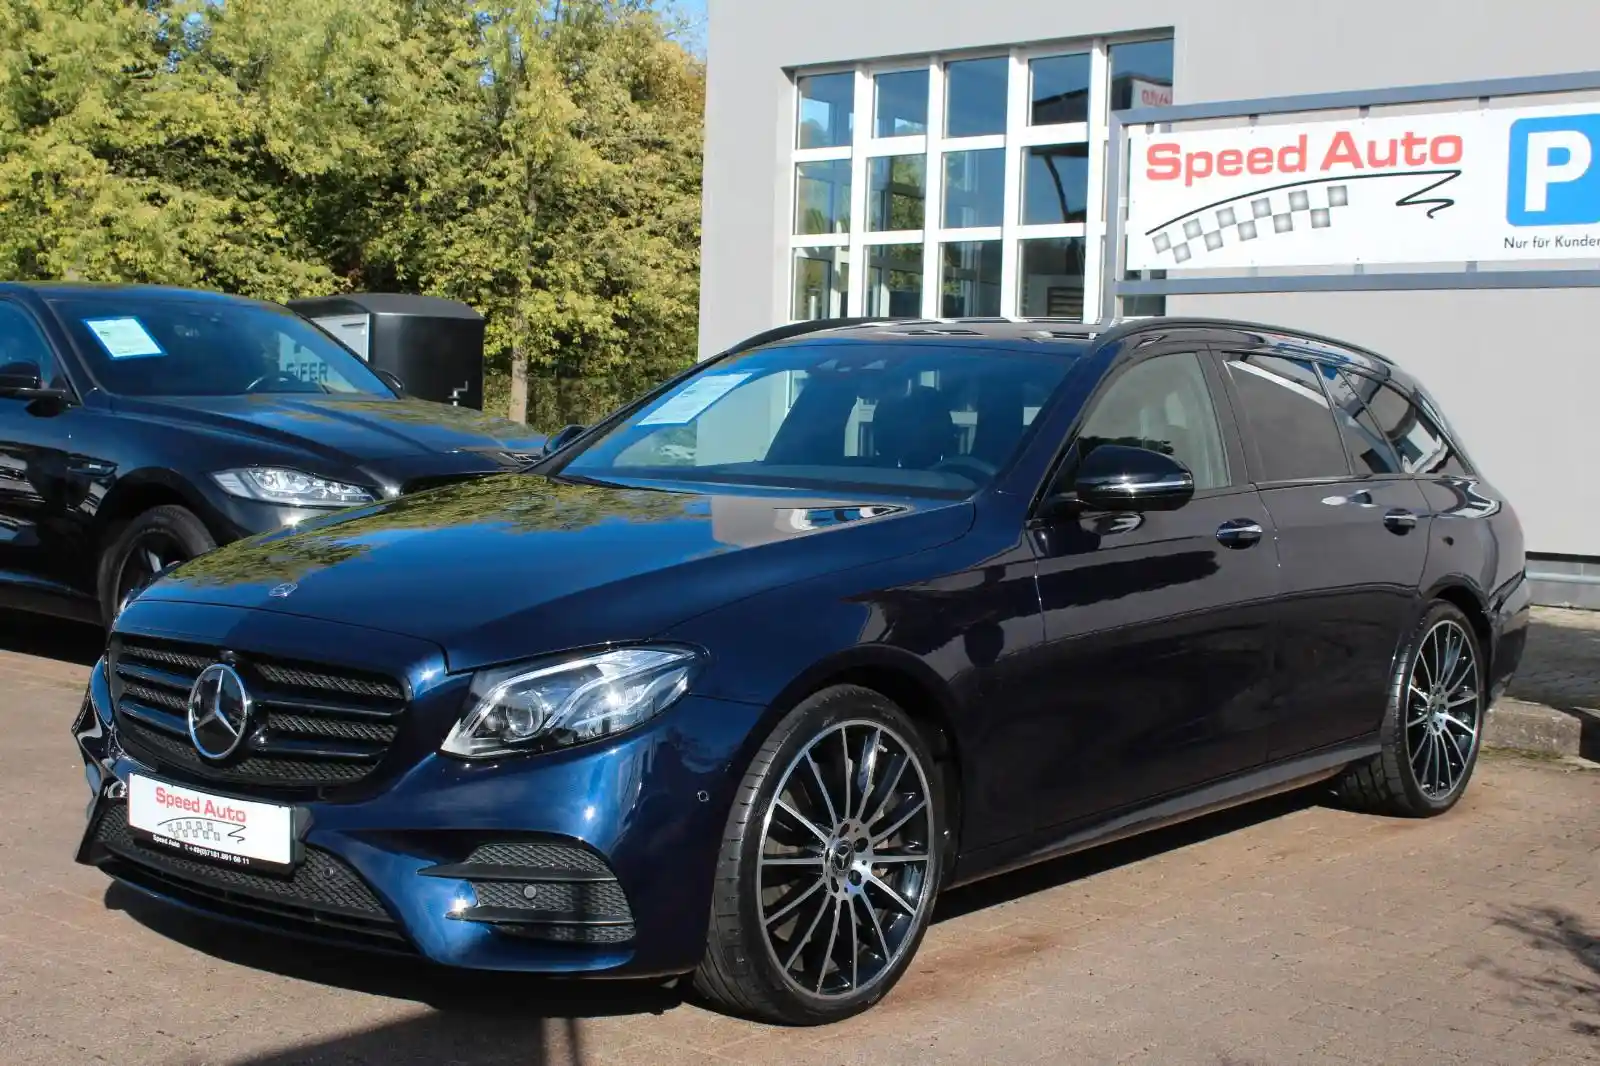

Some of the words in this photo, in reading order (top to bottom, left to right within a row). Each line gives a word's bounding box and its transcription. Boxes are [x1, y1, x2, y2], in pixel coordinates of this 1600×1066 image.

[1146, 133, 1307, 187] Speed
[1320, 131, 1463, 171] Auto
[1524, 130, 1592, 212] P
[1504, 235, 1528, 249] Nur
[1533, 235, 1551, 249] für
[156, 786, 200, 813] Speed
[204, 799, 246, 822] Auto
